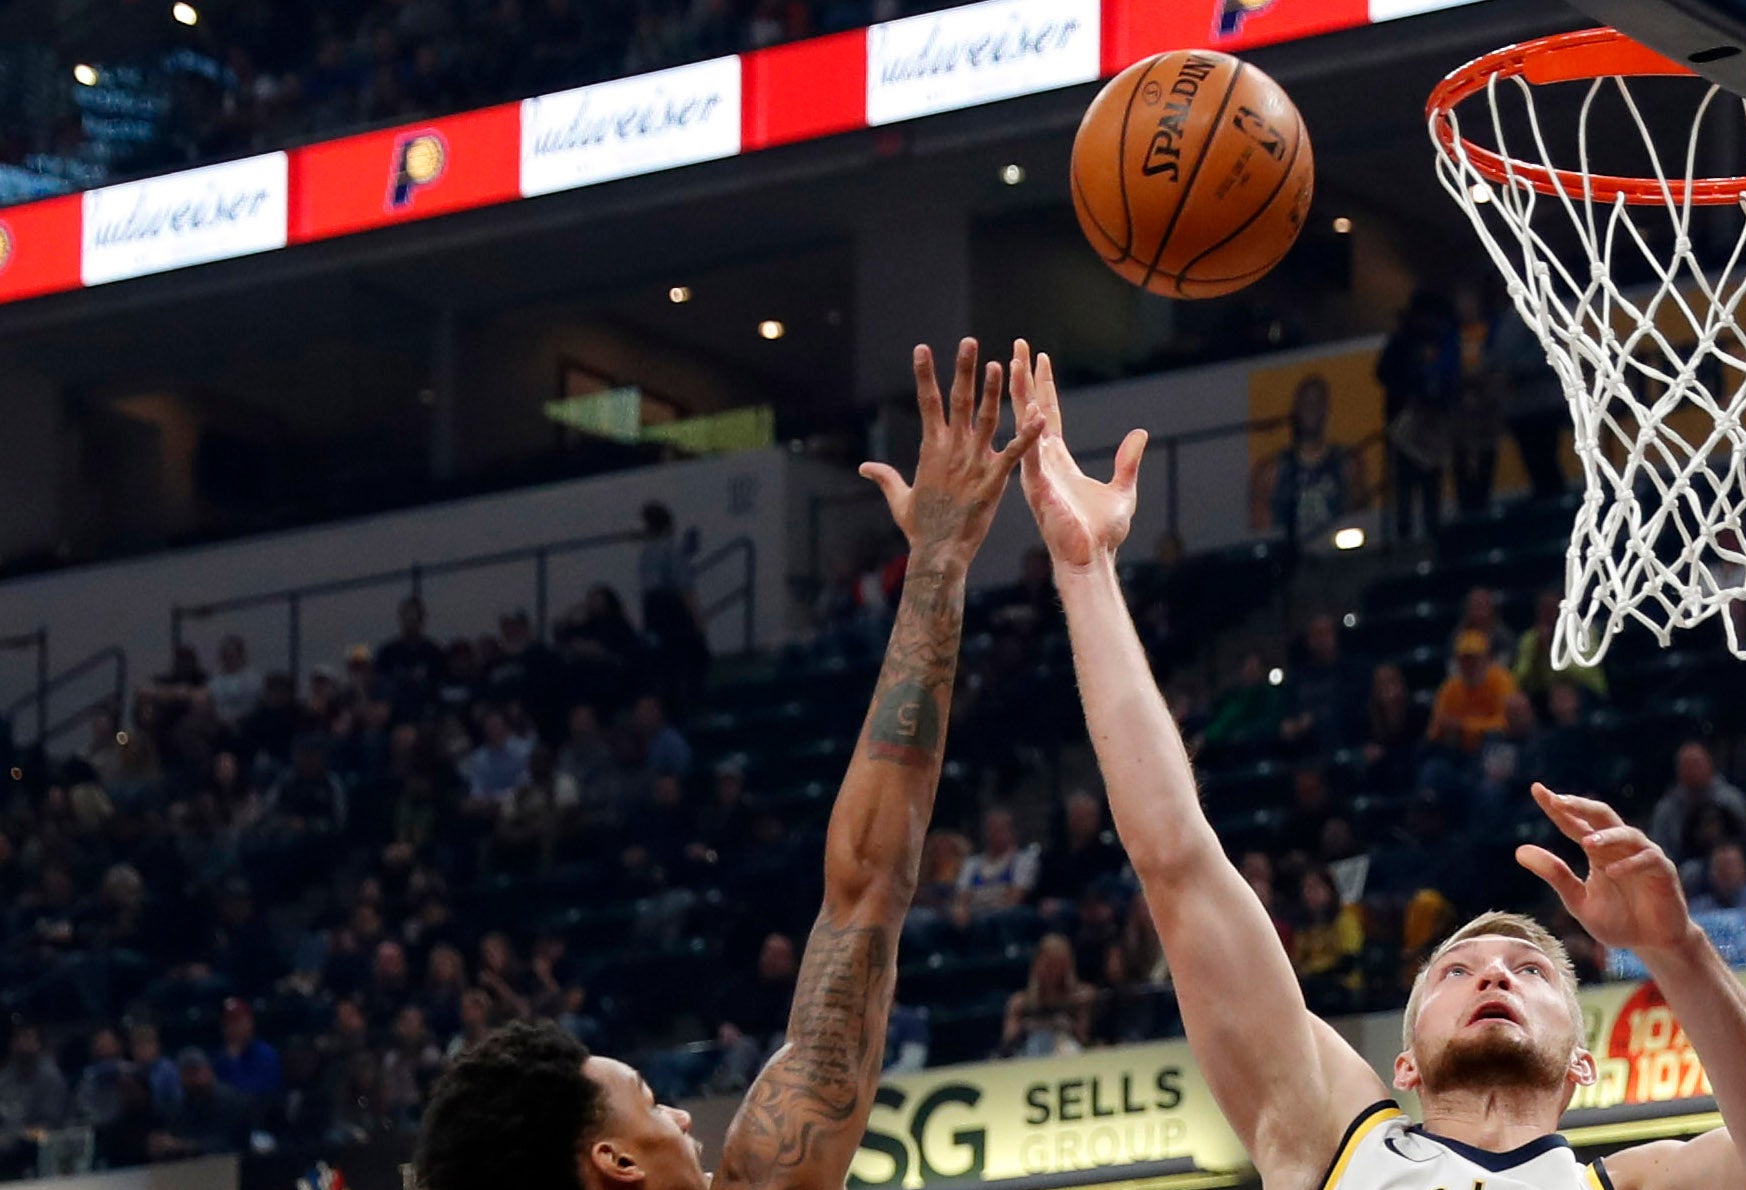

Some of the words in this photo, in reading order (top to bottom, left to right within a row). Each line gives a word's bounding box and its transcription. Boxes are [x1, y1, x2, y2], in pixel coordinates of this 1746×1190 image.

[1142, 55, 1220, 183] SPALDIN
[1025, 1067, 1184, 1127] SELLS
[1019, 1117, 1188, 1176] GROUP
